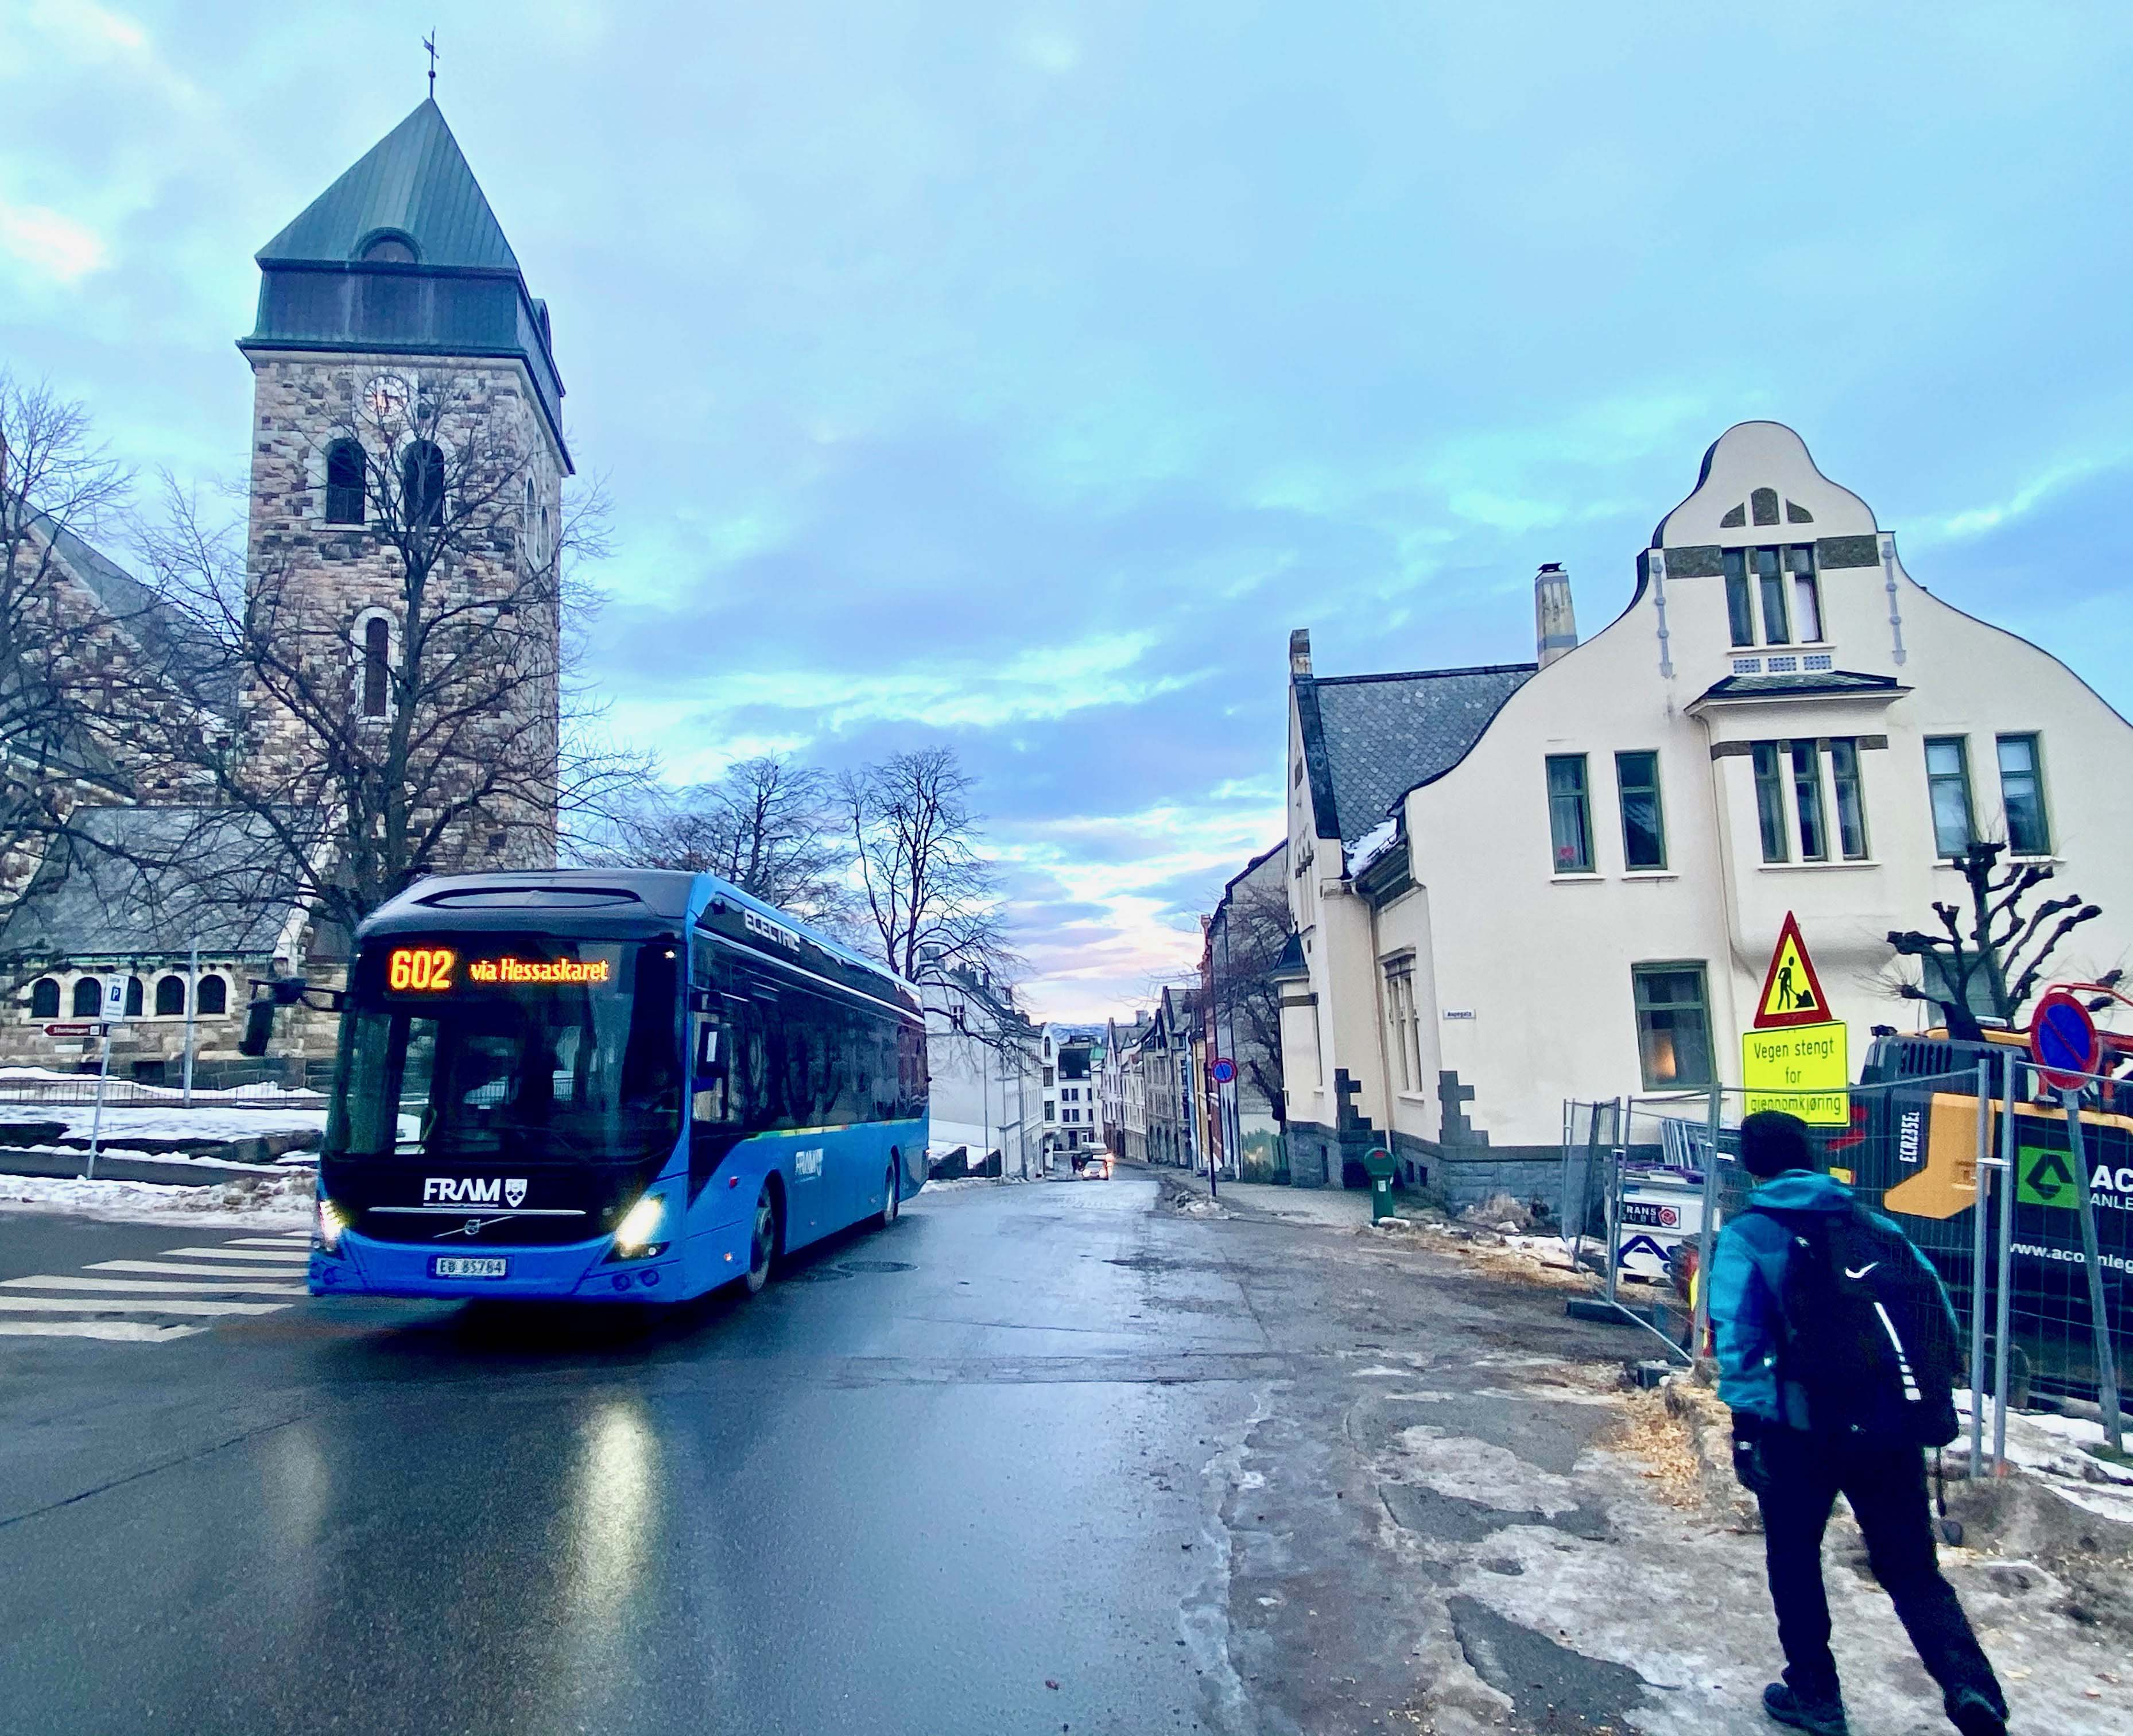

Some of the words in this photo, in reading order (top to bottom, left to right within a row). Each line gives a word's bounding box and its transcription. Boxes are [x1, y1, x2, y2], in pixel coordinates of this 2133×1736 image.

[390, 950, 452, 989] 602
[471, 960, 497, 981] via
[501, 958, 609, 982] Hessaskaret
[1754, 1042, 1789, 1063] Vegen
[1794, 1037, 1834, 1059] stengt
[1785, 1066, 1801, 1084] for
[424, 1178, 501, 1202] FRAM
